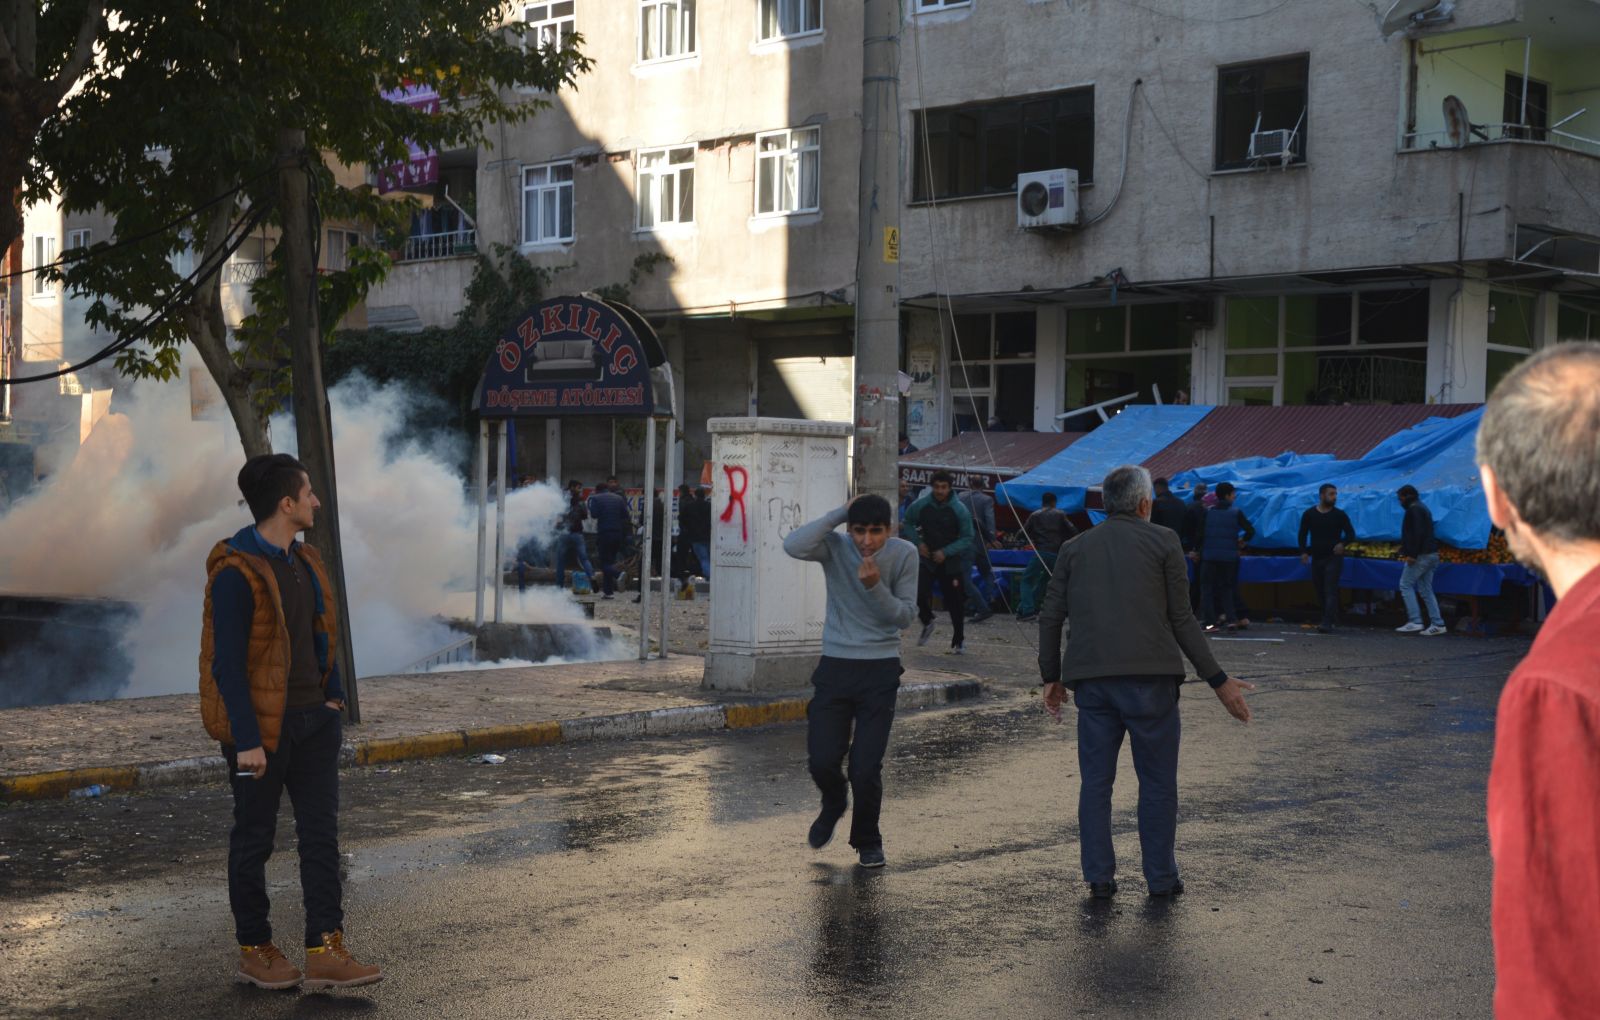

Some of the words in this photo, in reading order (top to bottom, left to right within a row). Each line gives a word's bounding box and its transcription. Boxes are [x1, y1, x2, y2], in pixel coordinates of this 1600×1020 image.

[496, 303, 638, 375] ÖZKILIÇ
[486, 384, 557, 412] DÖŞEME
[560, 382, 644, 407] ATÖLYESİ
[720, 464, 748, 544] R
